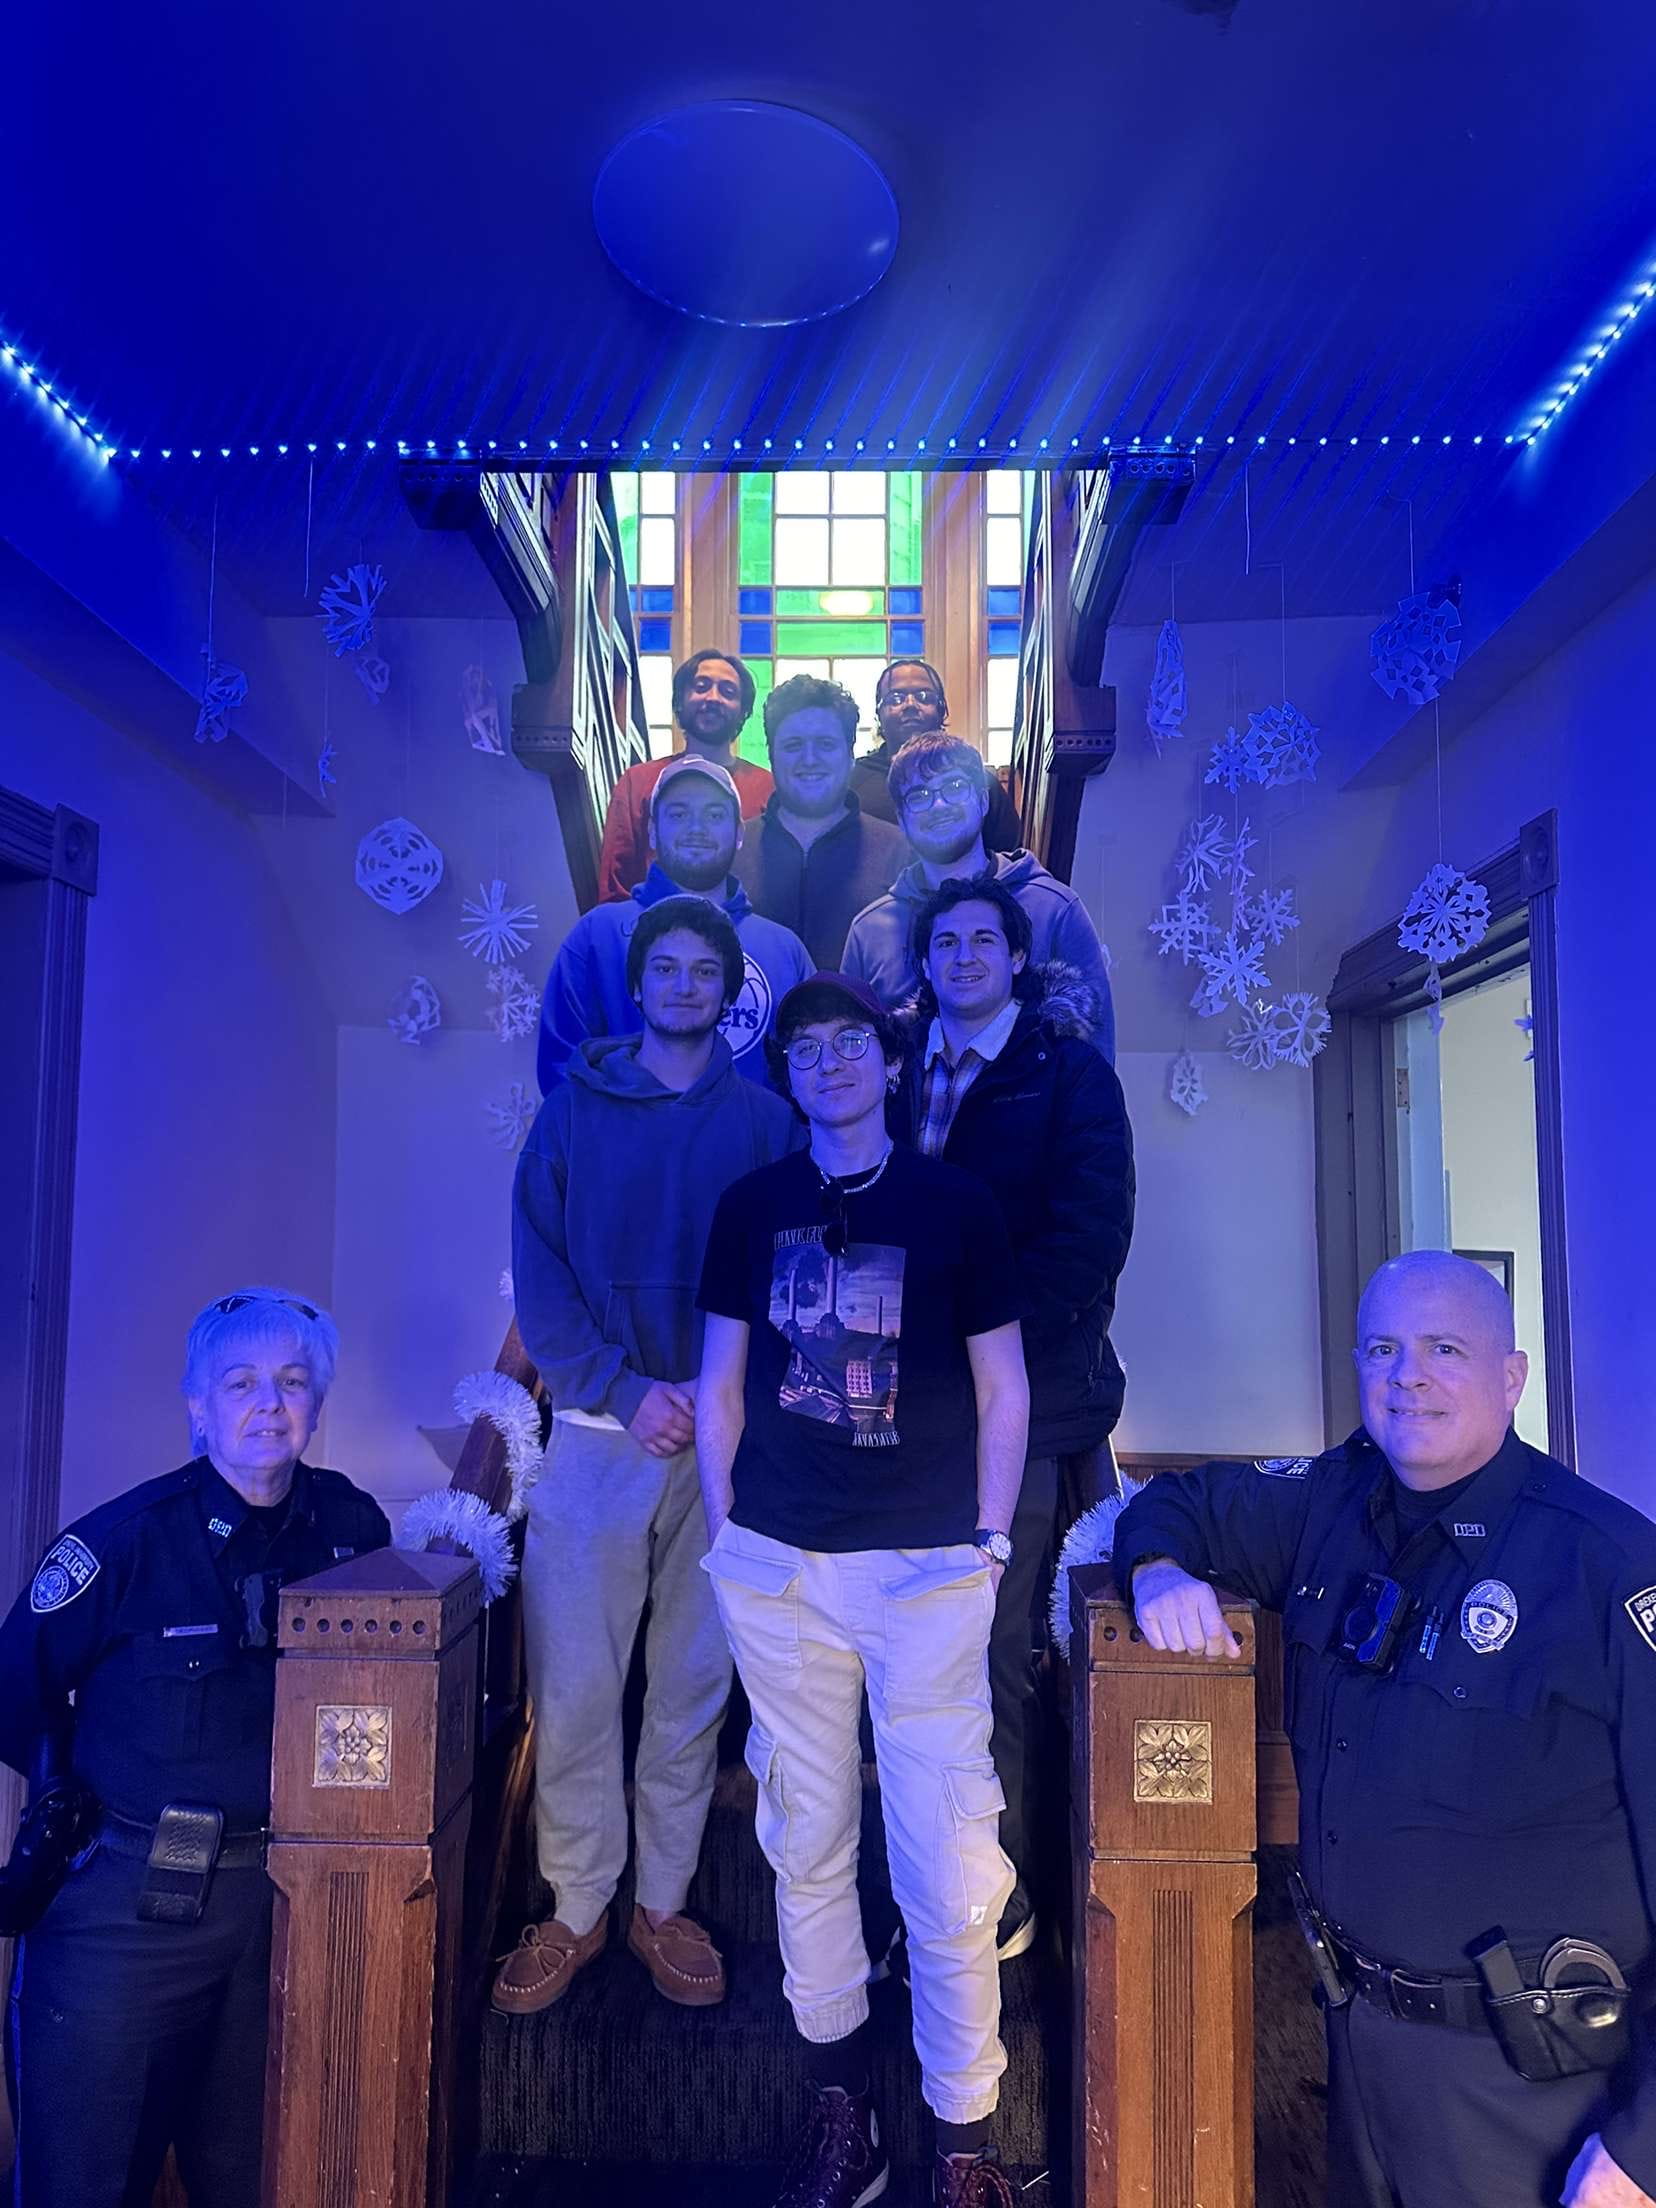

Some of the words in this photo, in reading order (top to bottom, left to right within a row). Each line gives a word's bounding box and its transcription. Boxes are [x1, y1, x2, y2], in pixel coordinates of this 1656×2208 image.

[719, 1007, 759, 1030] ers
[1454, 1523, 1486, 1537] DPD
[50, 1545, 90, 1586] POLICE
